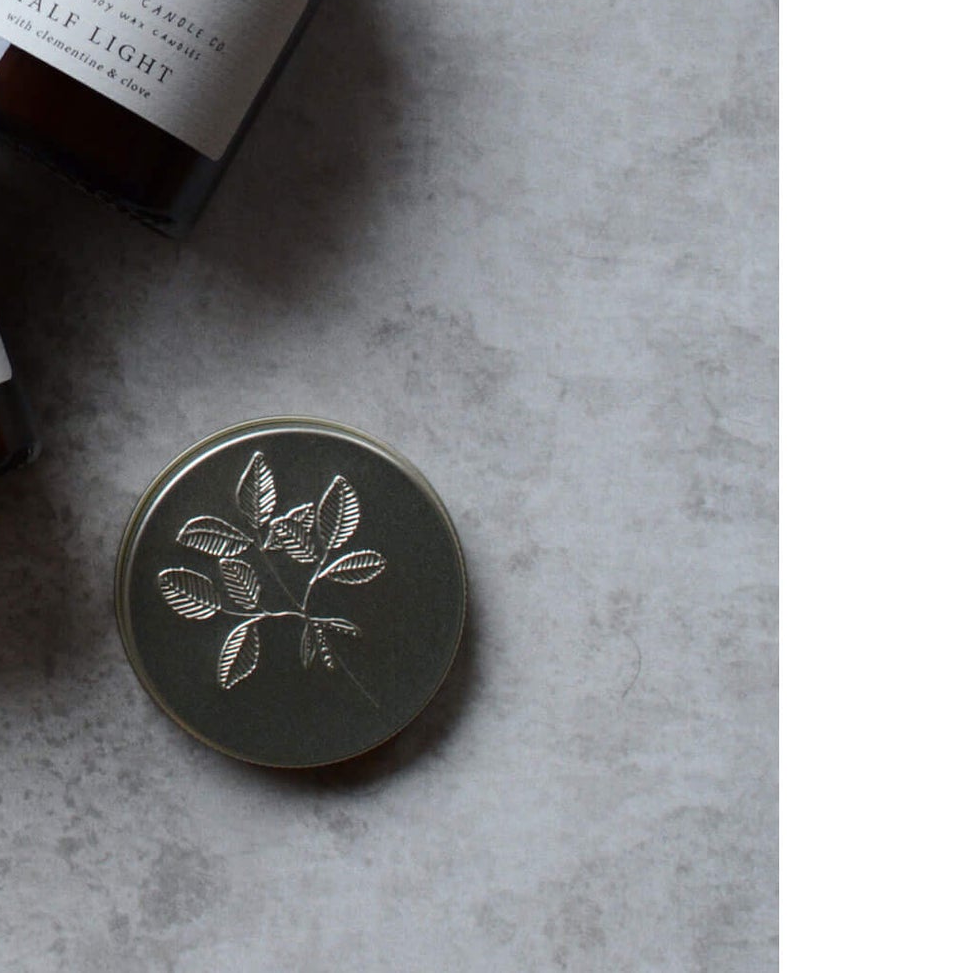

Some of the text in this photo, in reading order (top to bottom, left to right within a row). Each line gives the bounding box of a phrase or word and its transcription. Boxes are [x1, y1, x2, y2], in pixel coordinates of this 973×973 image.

[7, 12, 150, 99] with clementine & clove
[88, 27, 173, 83] LIGHT
[120, 11, 144, 30] WAX
[153, 29, 201, 61] CANDLES
[209, 36, 226, 54] CO.
